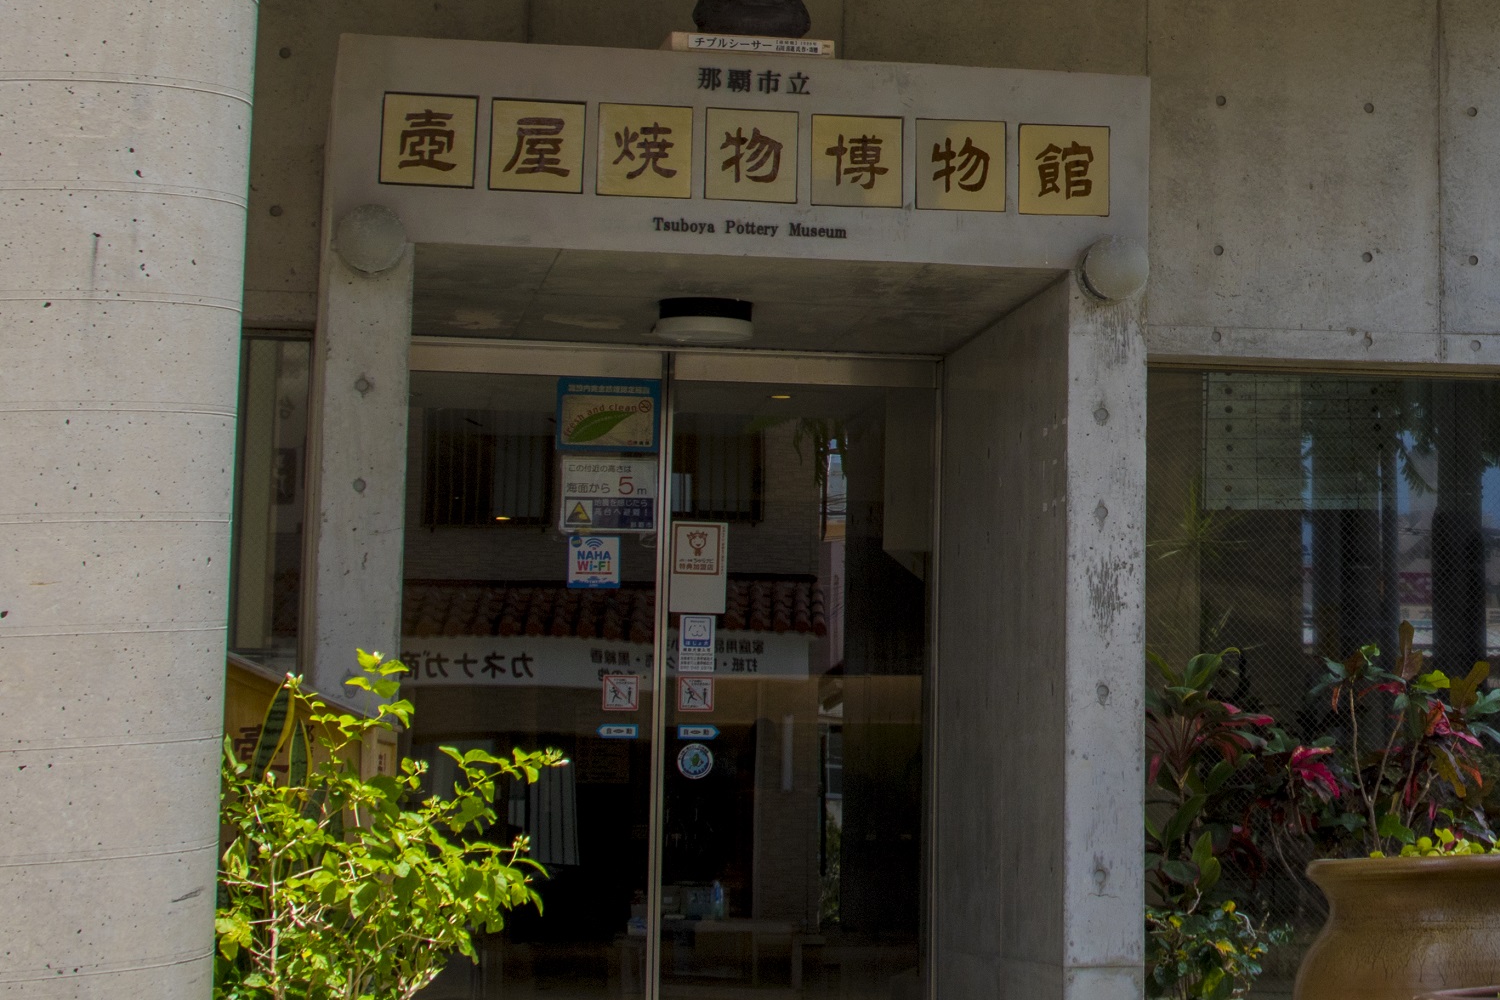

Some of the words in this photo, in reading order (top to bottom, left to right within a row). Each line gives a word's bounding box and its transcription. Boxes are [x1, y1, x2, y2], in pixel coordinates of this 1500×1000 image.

[694, 36, 773, 50] チブルシーサー
[697, 67, 812, 95] 那覇市立
[398, 109, 1095, 200] 壺屋焼物博物館
[653, 217, 715, 234] Tsuboya
[725, 220, 779, 237] Pottery
[789, 223, 847, 239] Museum
[563, 413, 584, 437] fresh
[587, 404, 605, 416] and
[609, 403, 638, 412] clean
[568, 464, 632, 473] この付近の高さは
[566, 482, 611, 494] 海面から
[618, 476, 634, 495] 5
[636, 487, 647, 495] m
[577, 550, 612, 560] NAHA
[577, 561, 611, 571] Wi-Fi
